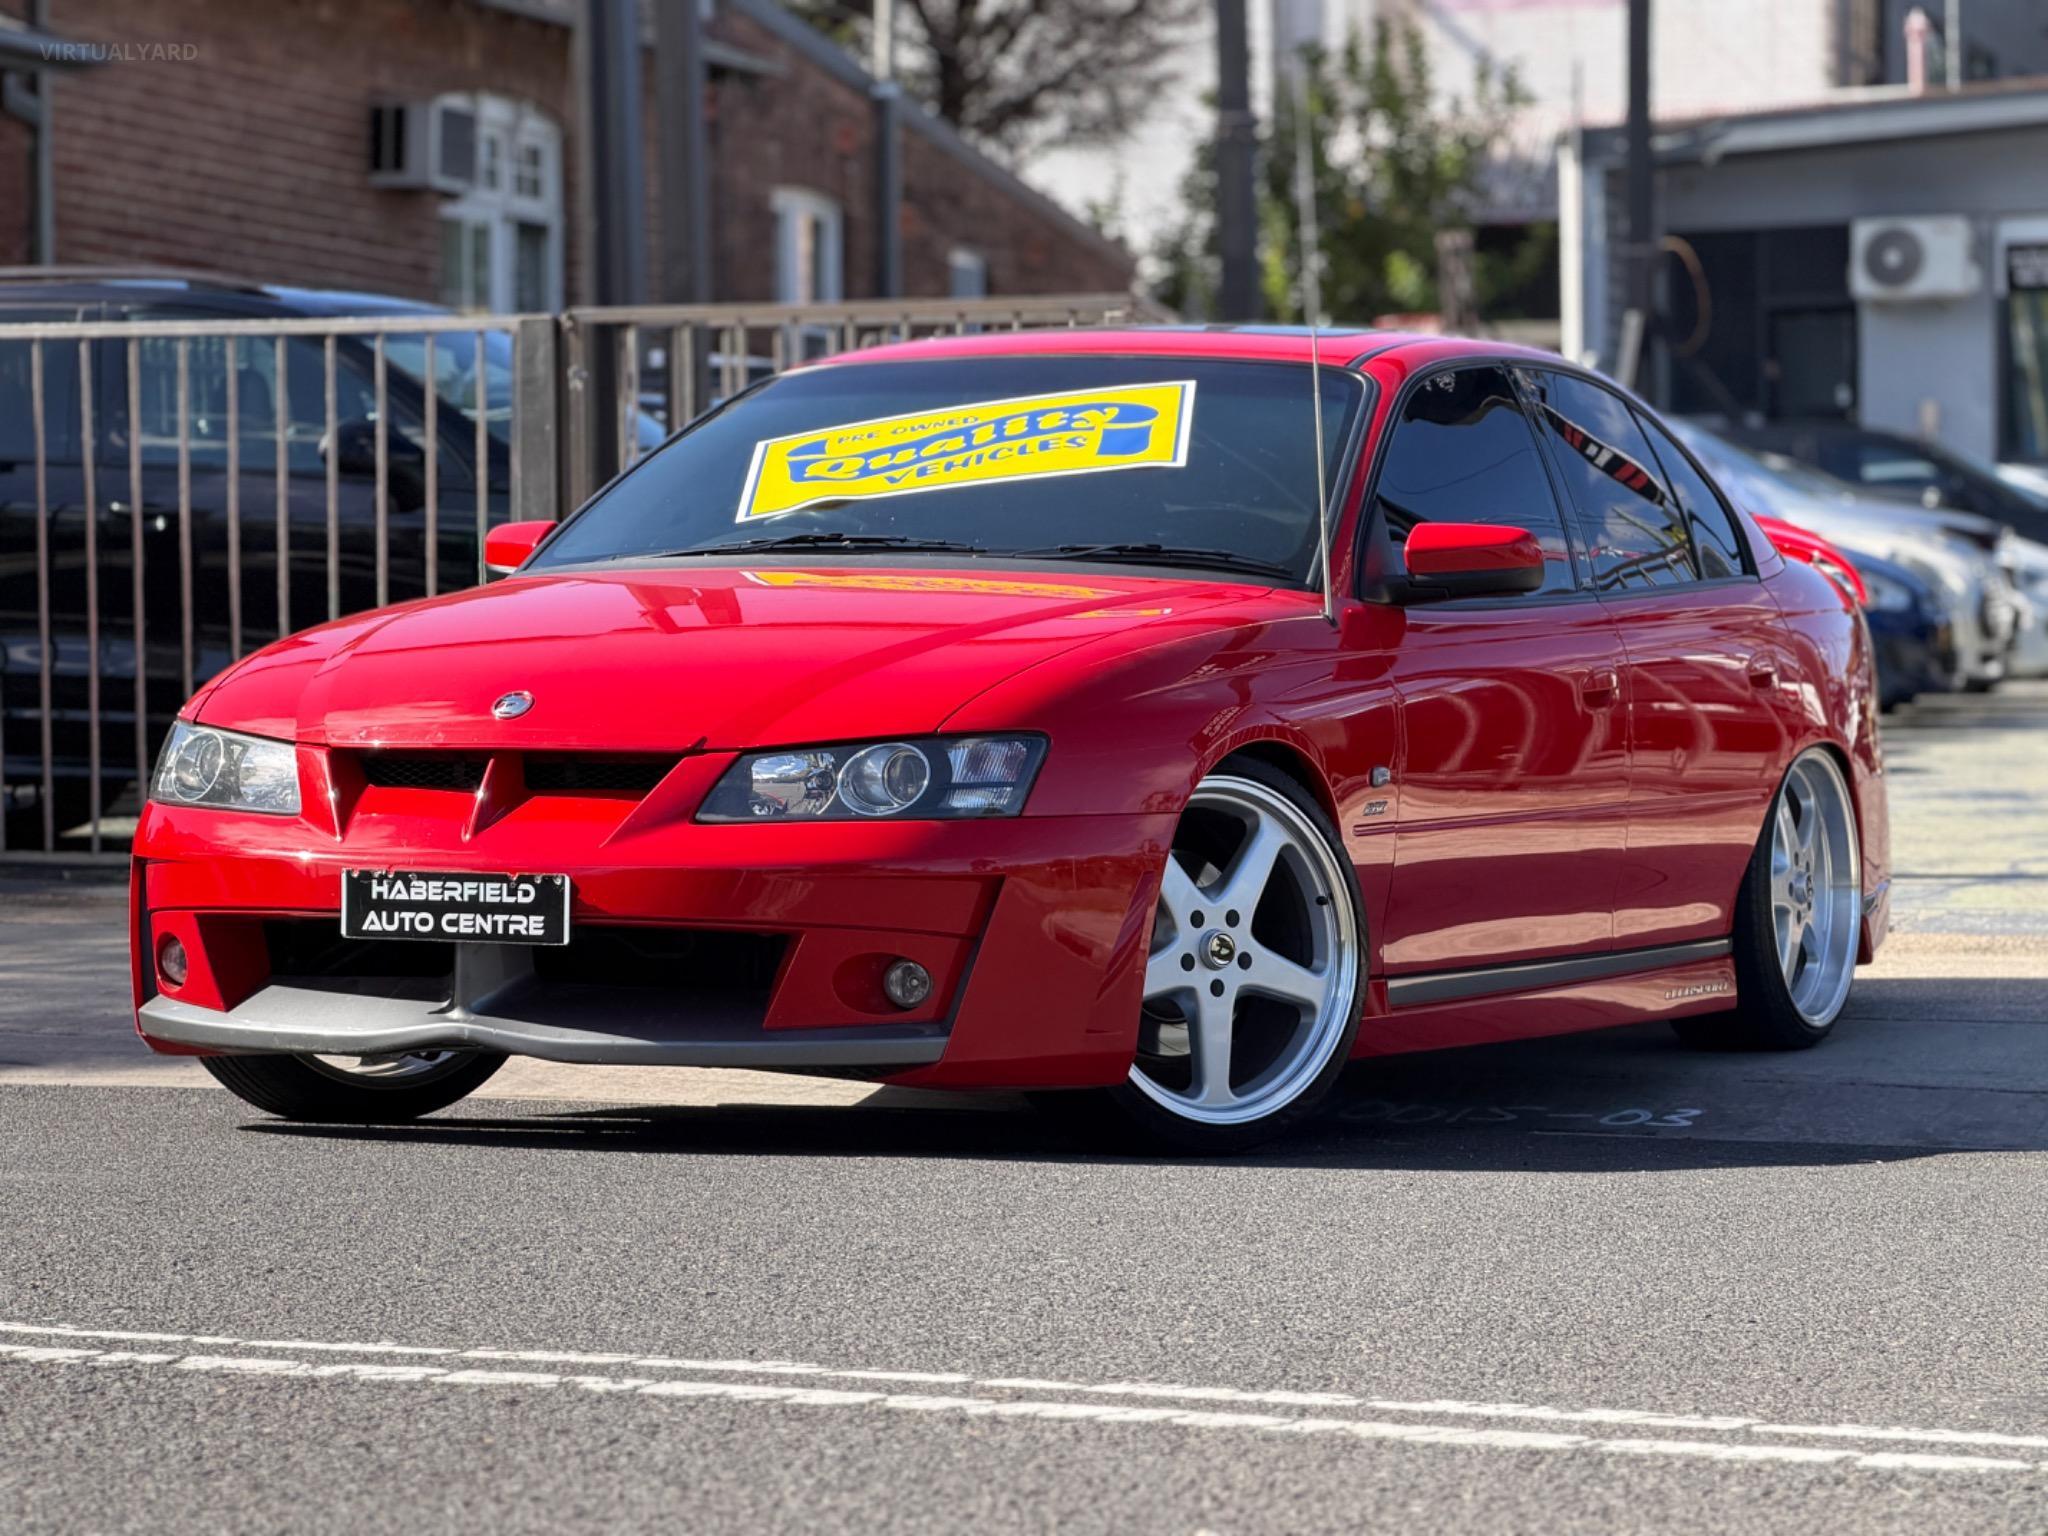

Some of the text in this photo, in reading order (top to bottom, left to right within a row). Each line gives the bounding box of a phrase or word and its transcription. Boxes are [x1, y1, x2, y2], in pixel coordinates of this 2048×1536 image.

[804, 406, 1120, 480] Quality
[837, 415, 980, 444] PRE OWNED
[884, 435, 1088, 484] VEHICLES
[371, 880, 536, 904] HABERFIELD
[361, 910, 546, 936] AUTO CENTRE
